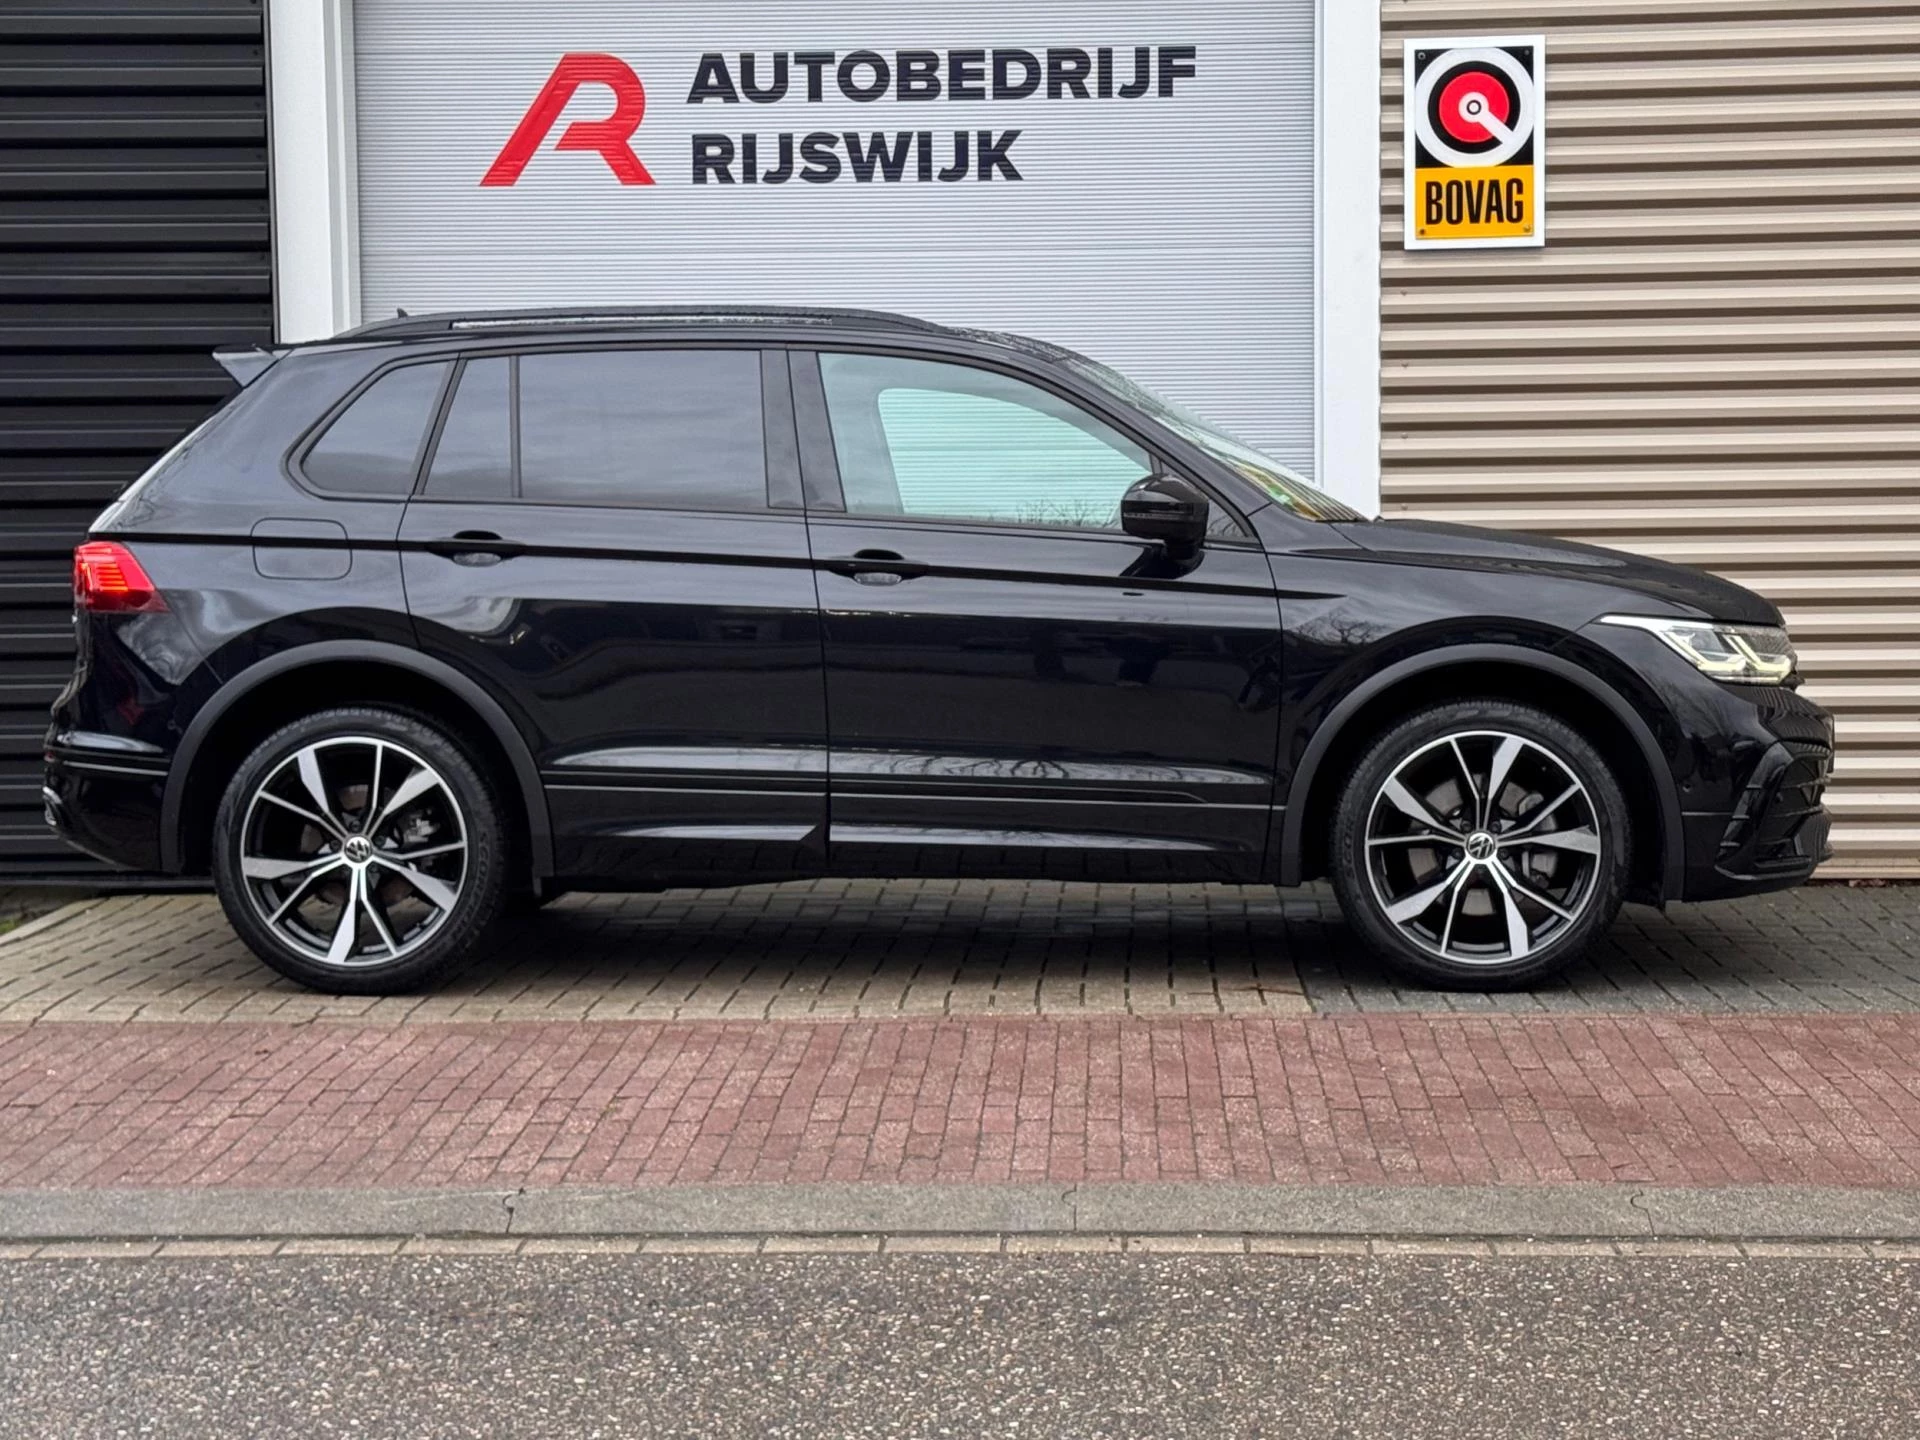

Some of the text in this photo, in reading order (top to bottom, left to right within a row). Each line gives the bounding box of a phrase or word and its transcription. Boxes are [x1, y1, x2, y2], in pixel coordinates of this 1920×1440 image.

[687, 46, 1196, 104] AUTOBEDRIJF
[691, 129, 1023, 185] RIJSWIJK
[1425, 178, 1524, 225] BOVAG
